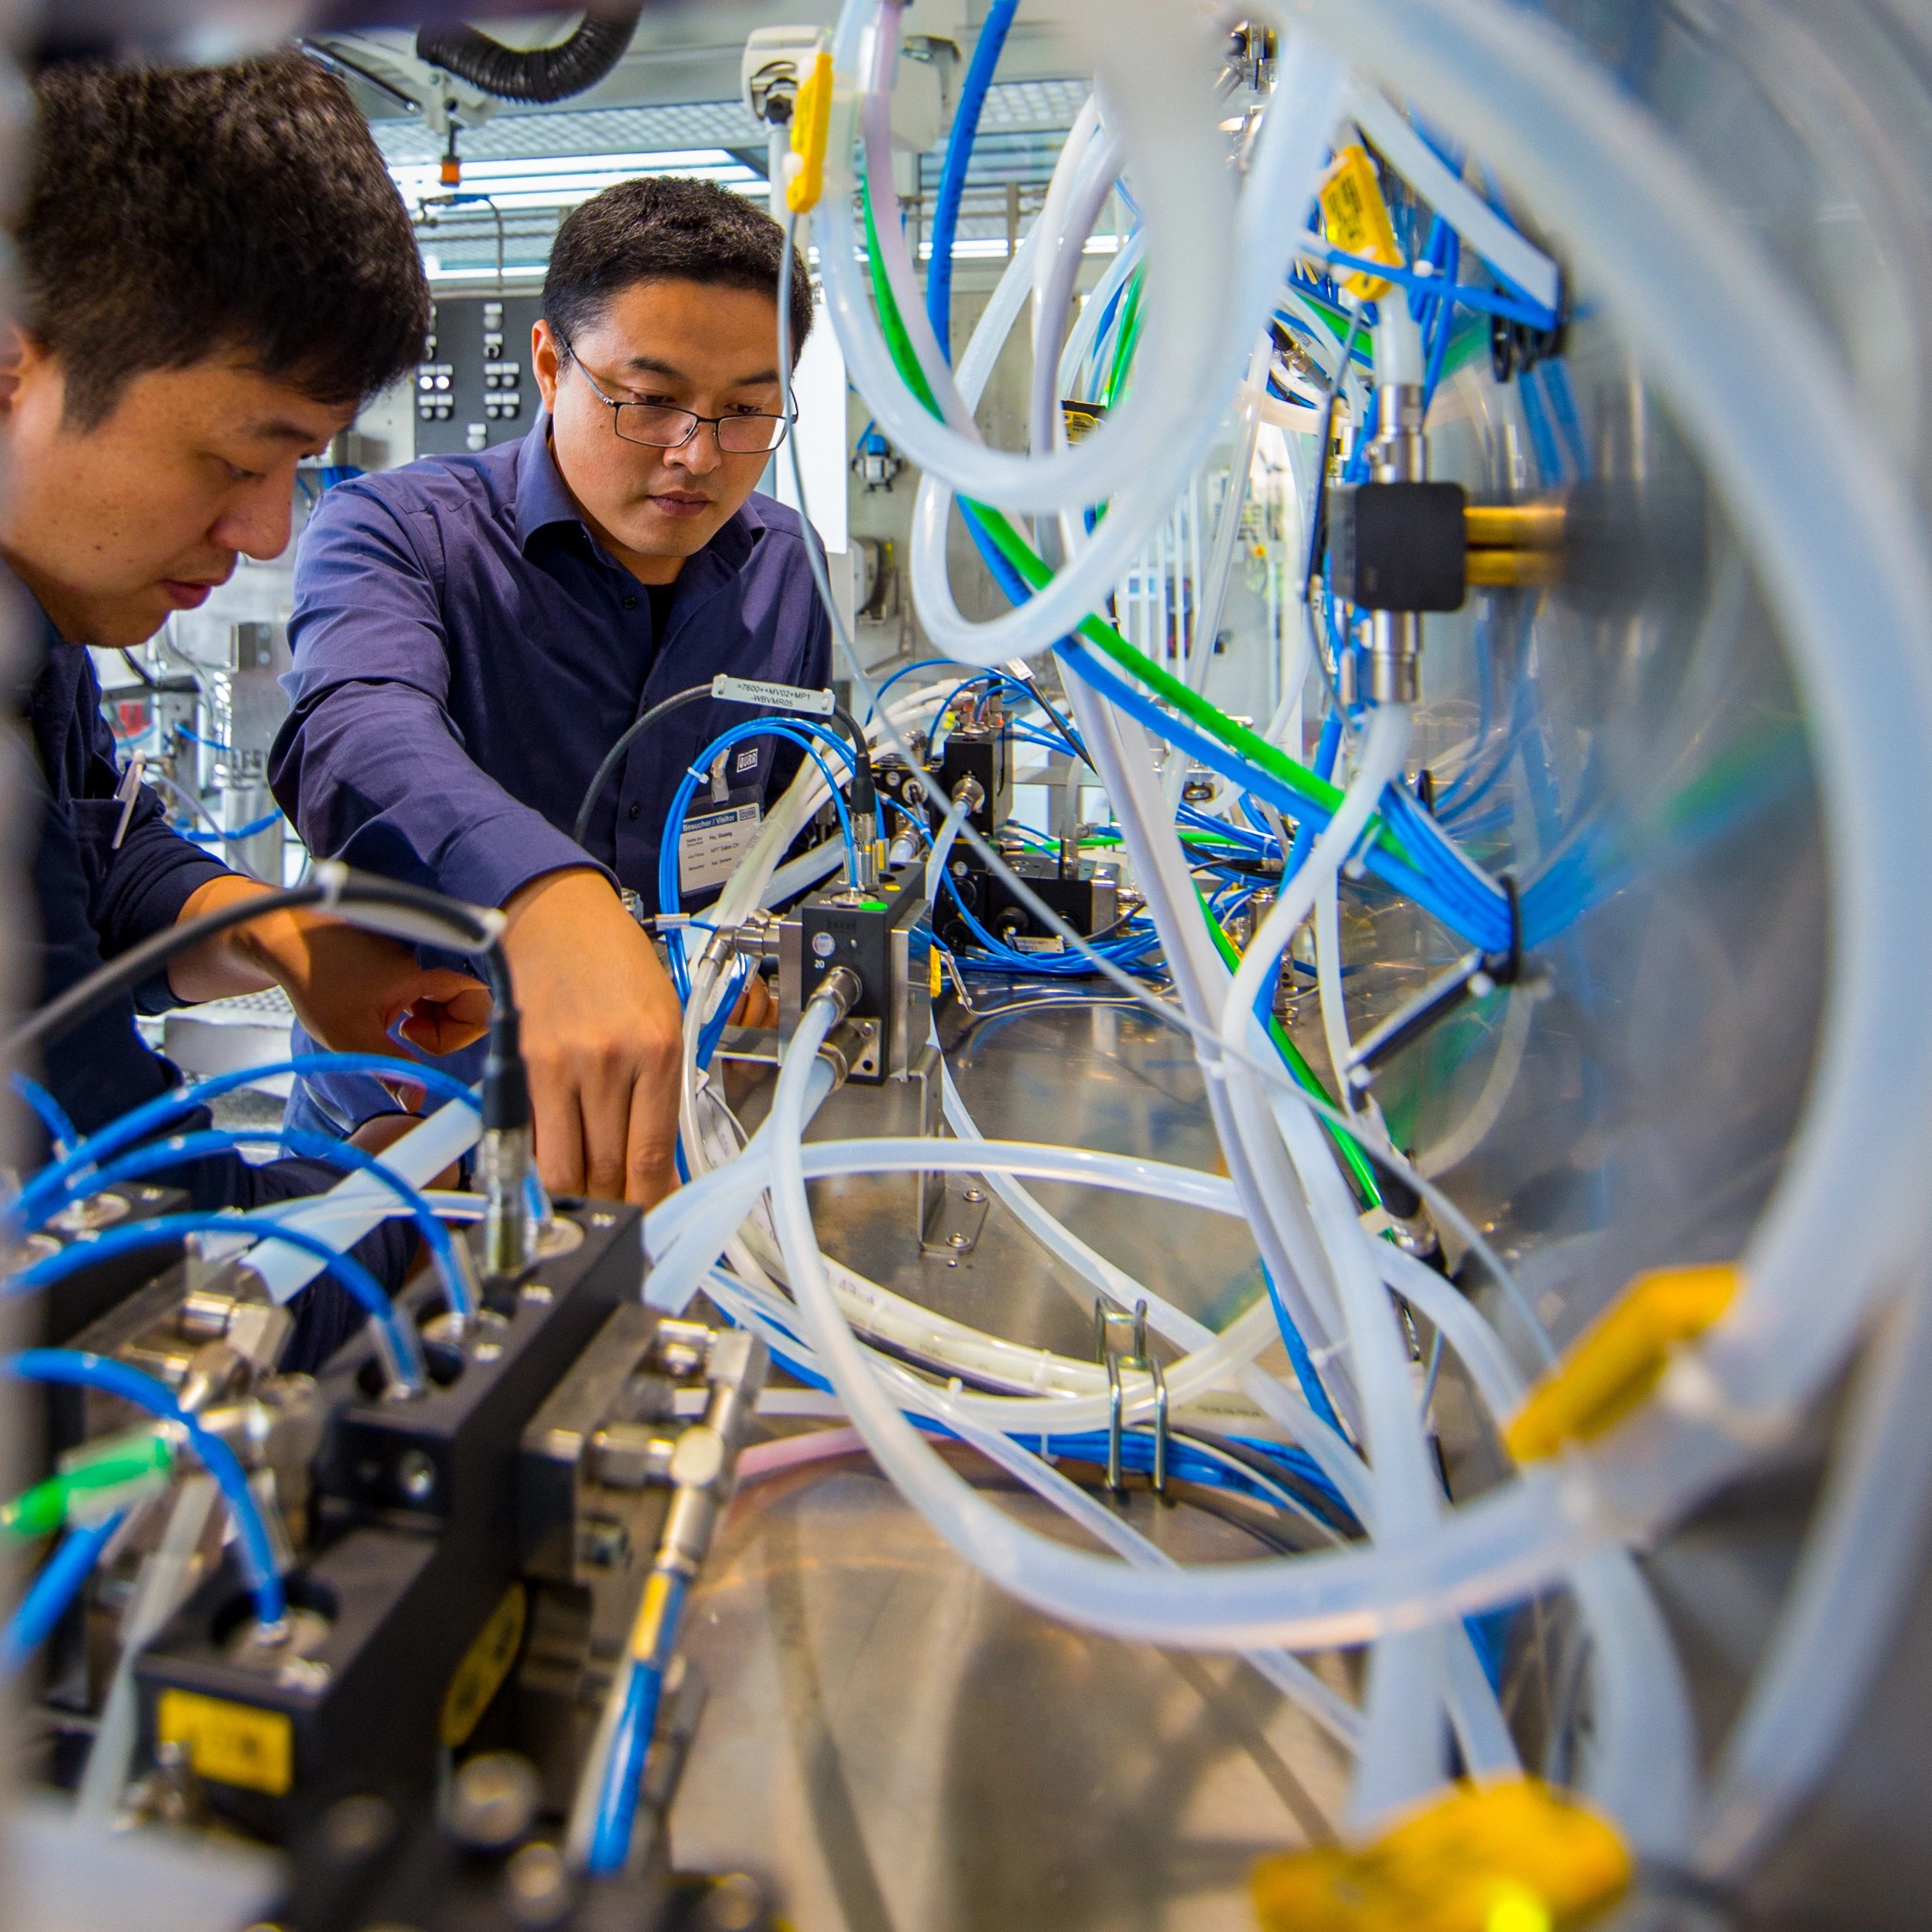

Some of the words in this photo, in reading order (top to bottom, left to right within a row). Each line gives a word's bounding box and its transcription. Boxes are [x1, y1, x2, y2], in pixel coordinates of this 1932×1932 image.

[683, 820, 712, 831] Besucher
[715, 814, 736, 824] Visitor
[814, 959, 824, 969] 20
